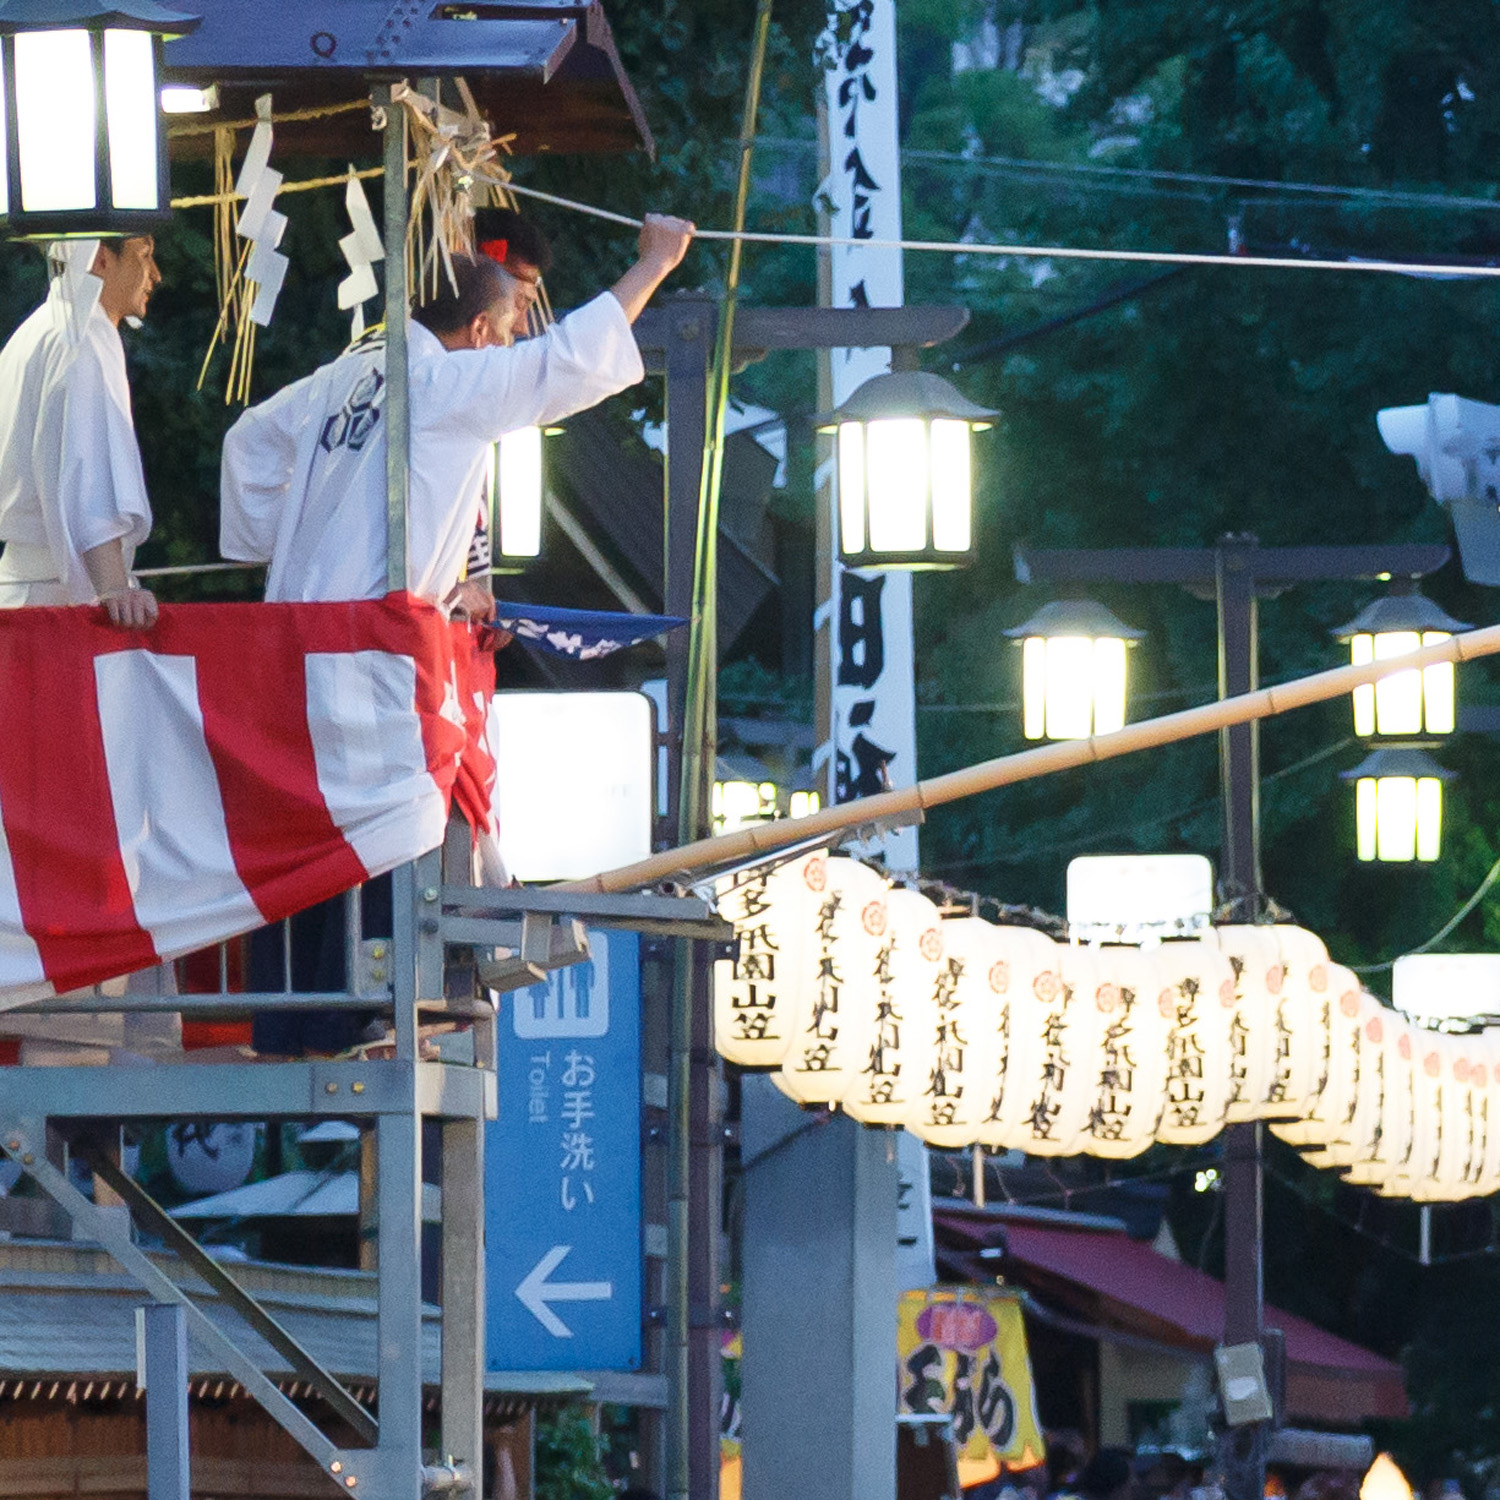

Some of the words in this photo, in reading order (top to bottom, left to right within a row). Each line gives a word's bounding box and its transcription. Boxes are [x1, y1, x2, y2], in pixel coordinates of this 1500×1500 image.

[528, 1051, 551, 1124] Toilet
[560, 1048, 597, 1212] お手洗い
